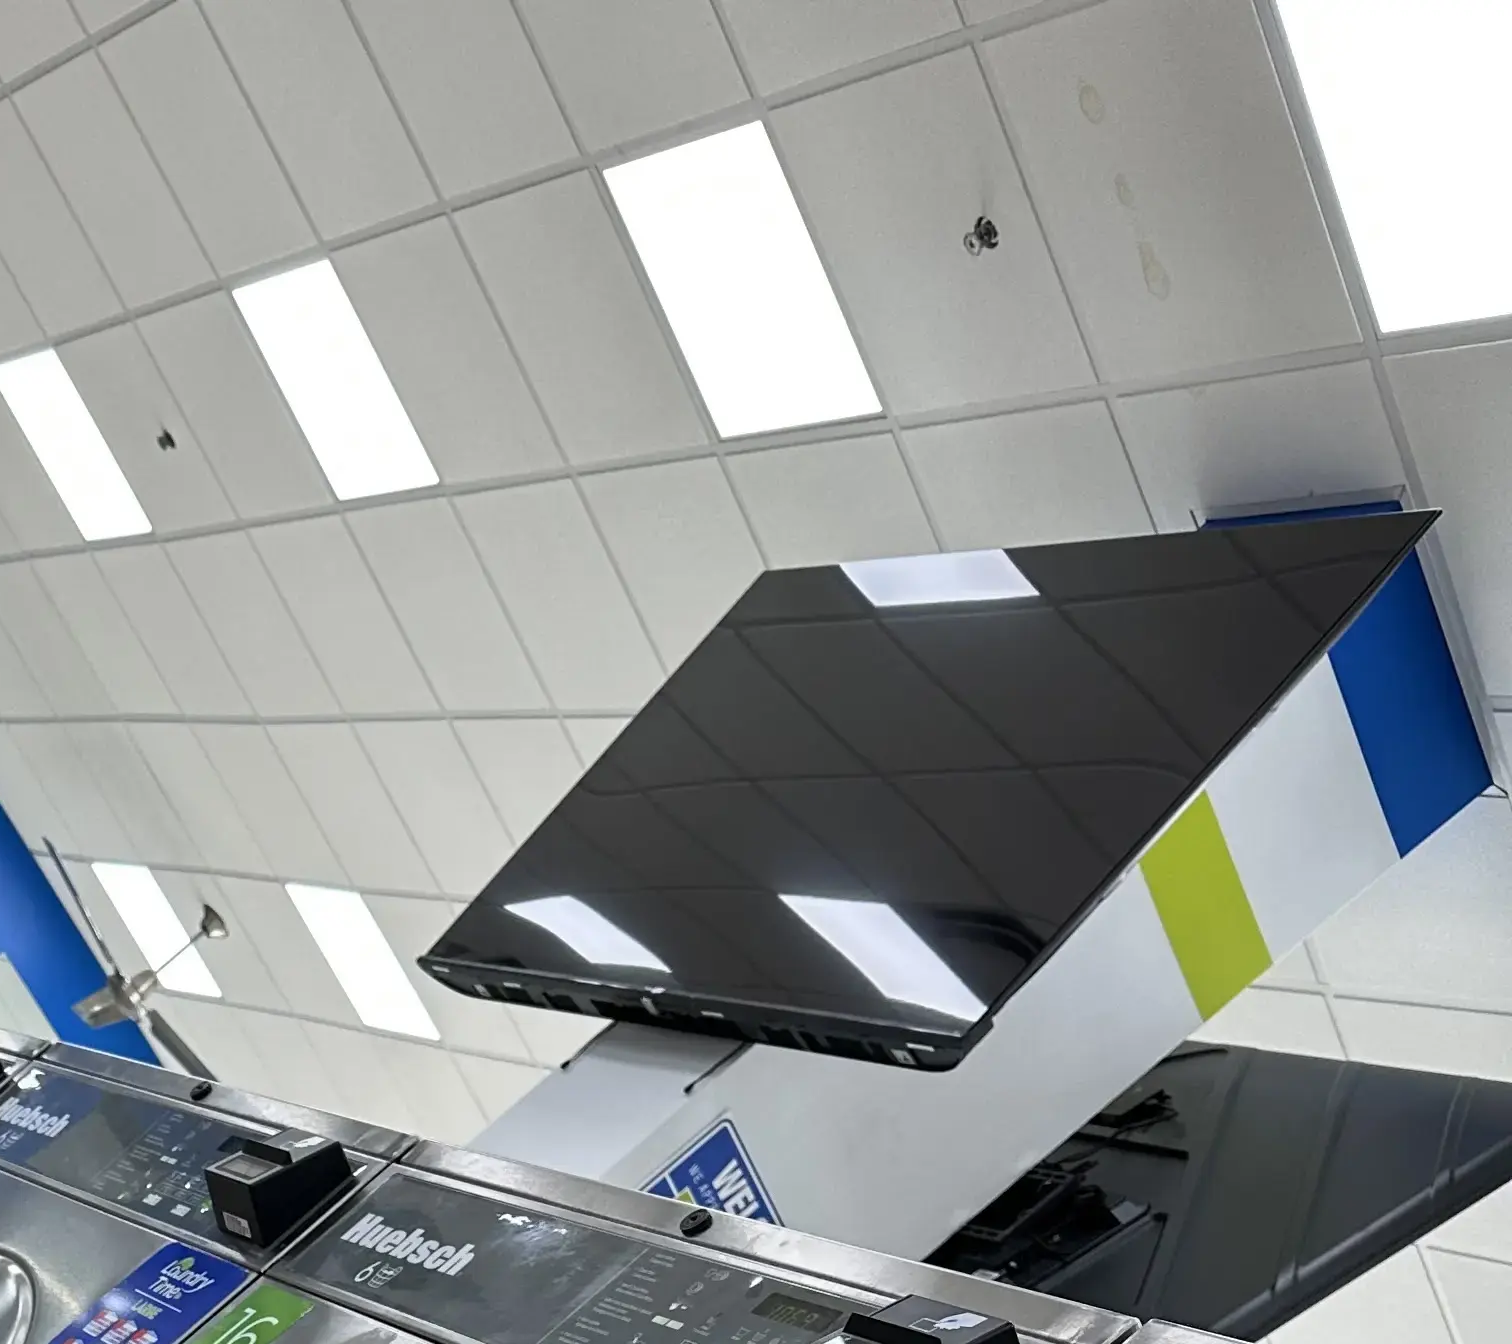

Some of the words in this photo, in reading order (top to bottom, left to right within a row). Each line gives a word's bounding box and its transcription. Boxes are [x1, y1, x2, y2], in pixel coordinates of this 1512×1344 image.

[712, 1158, 765, 1221] WEL
[340, 1212, 475, 1276] Huebsch
[148, 1276, 177, 1299] Time
[161, 1260, 216, 1293] Laundry
[354, 1261, 382, 1283] 6
